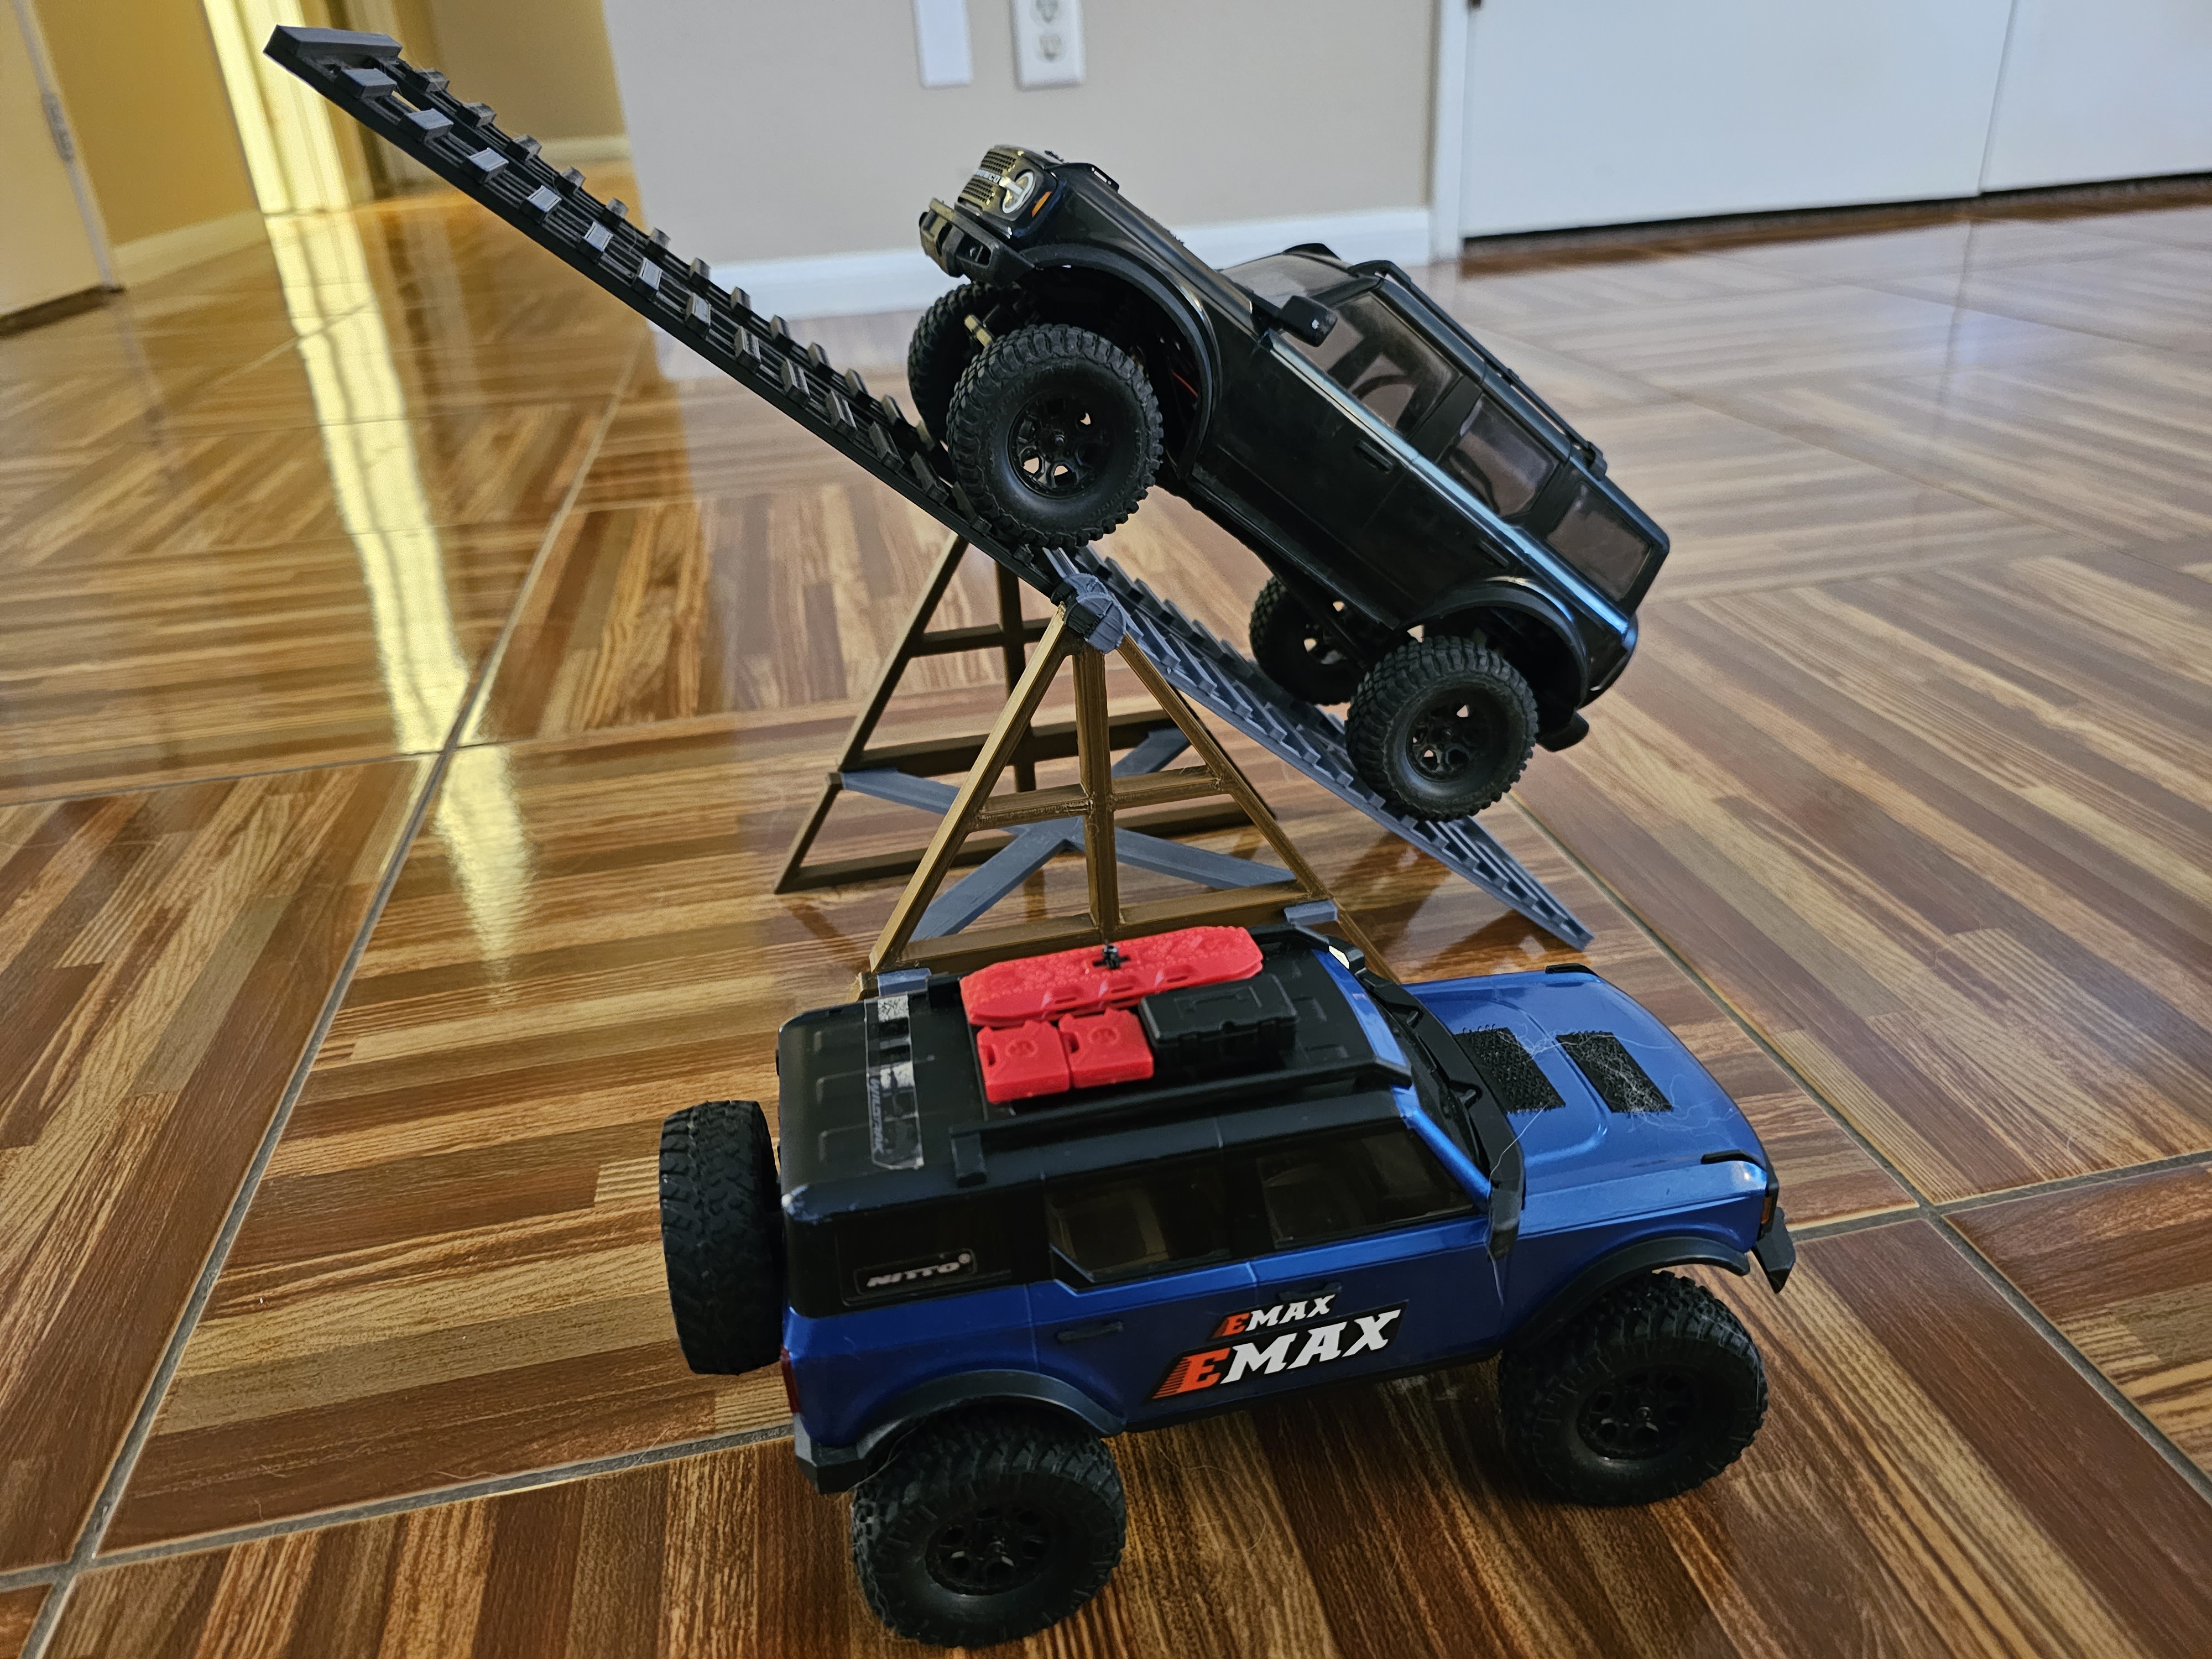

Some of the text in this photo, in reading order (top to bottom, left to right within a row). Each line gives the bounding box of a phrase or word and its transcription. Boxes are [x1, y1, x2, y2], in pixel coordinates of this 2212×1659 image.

[866, 1262, 961, 1287] NITTO
[1211, 1293, 1336, 1339] EMAX
[1152, 1309, 1401, 1400] EMAX
